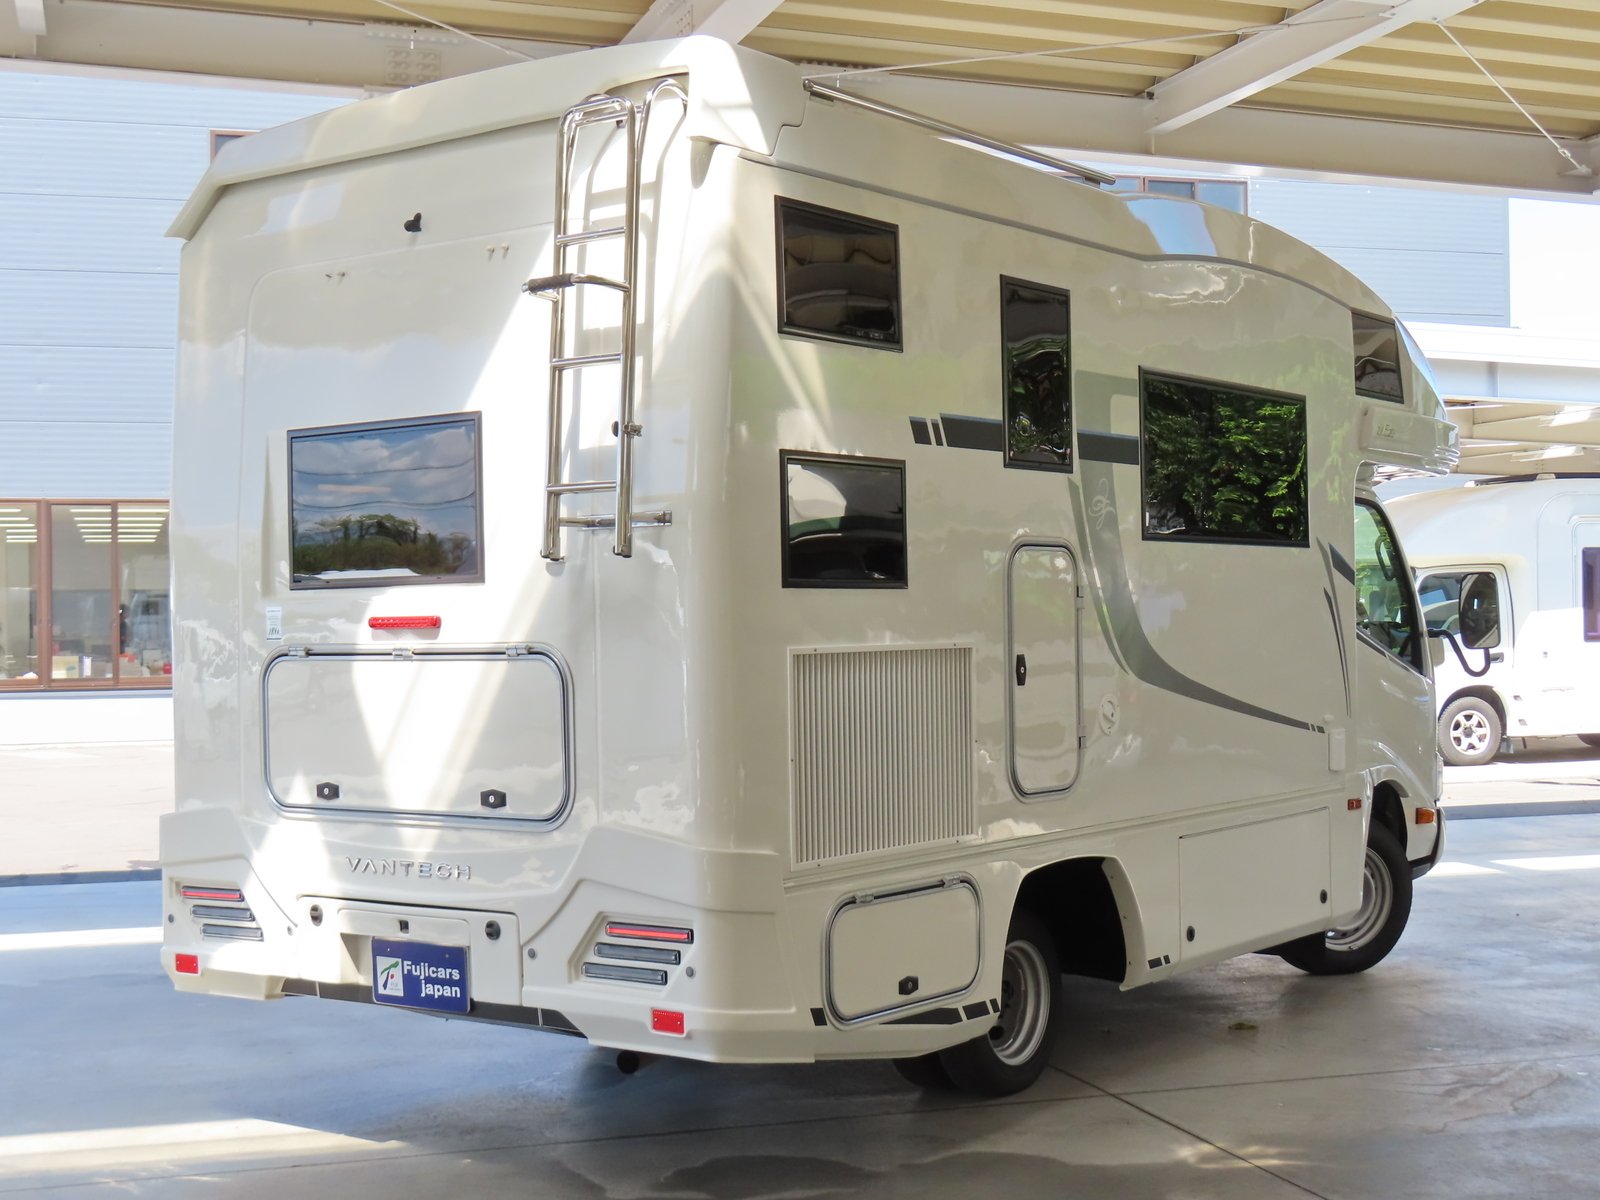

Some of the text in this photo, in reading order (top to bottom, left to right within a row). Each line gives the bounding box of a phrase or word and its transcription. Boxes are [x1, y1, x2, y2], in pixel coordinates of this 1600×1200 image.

[346, 857, 471, 879] VANTECH
[403, 960, 460, 980] Fujicars
[421, 980, 461, 998] japan
